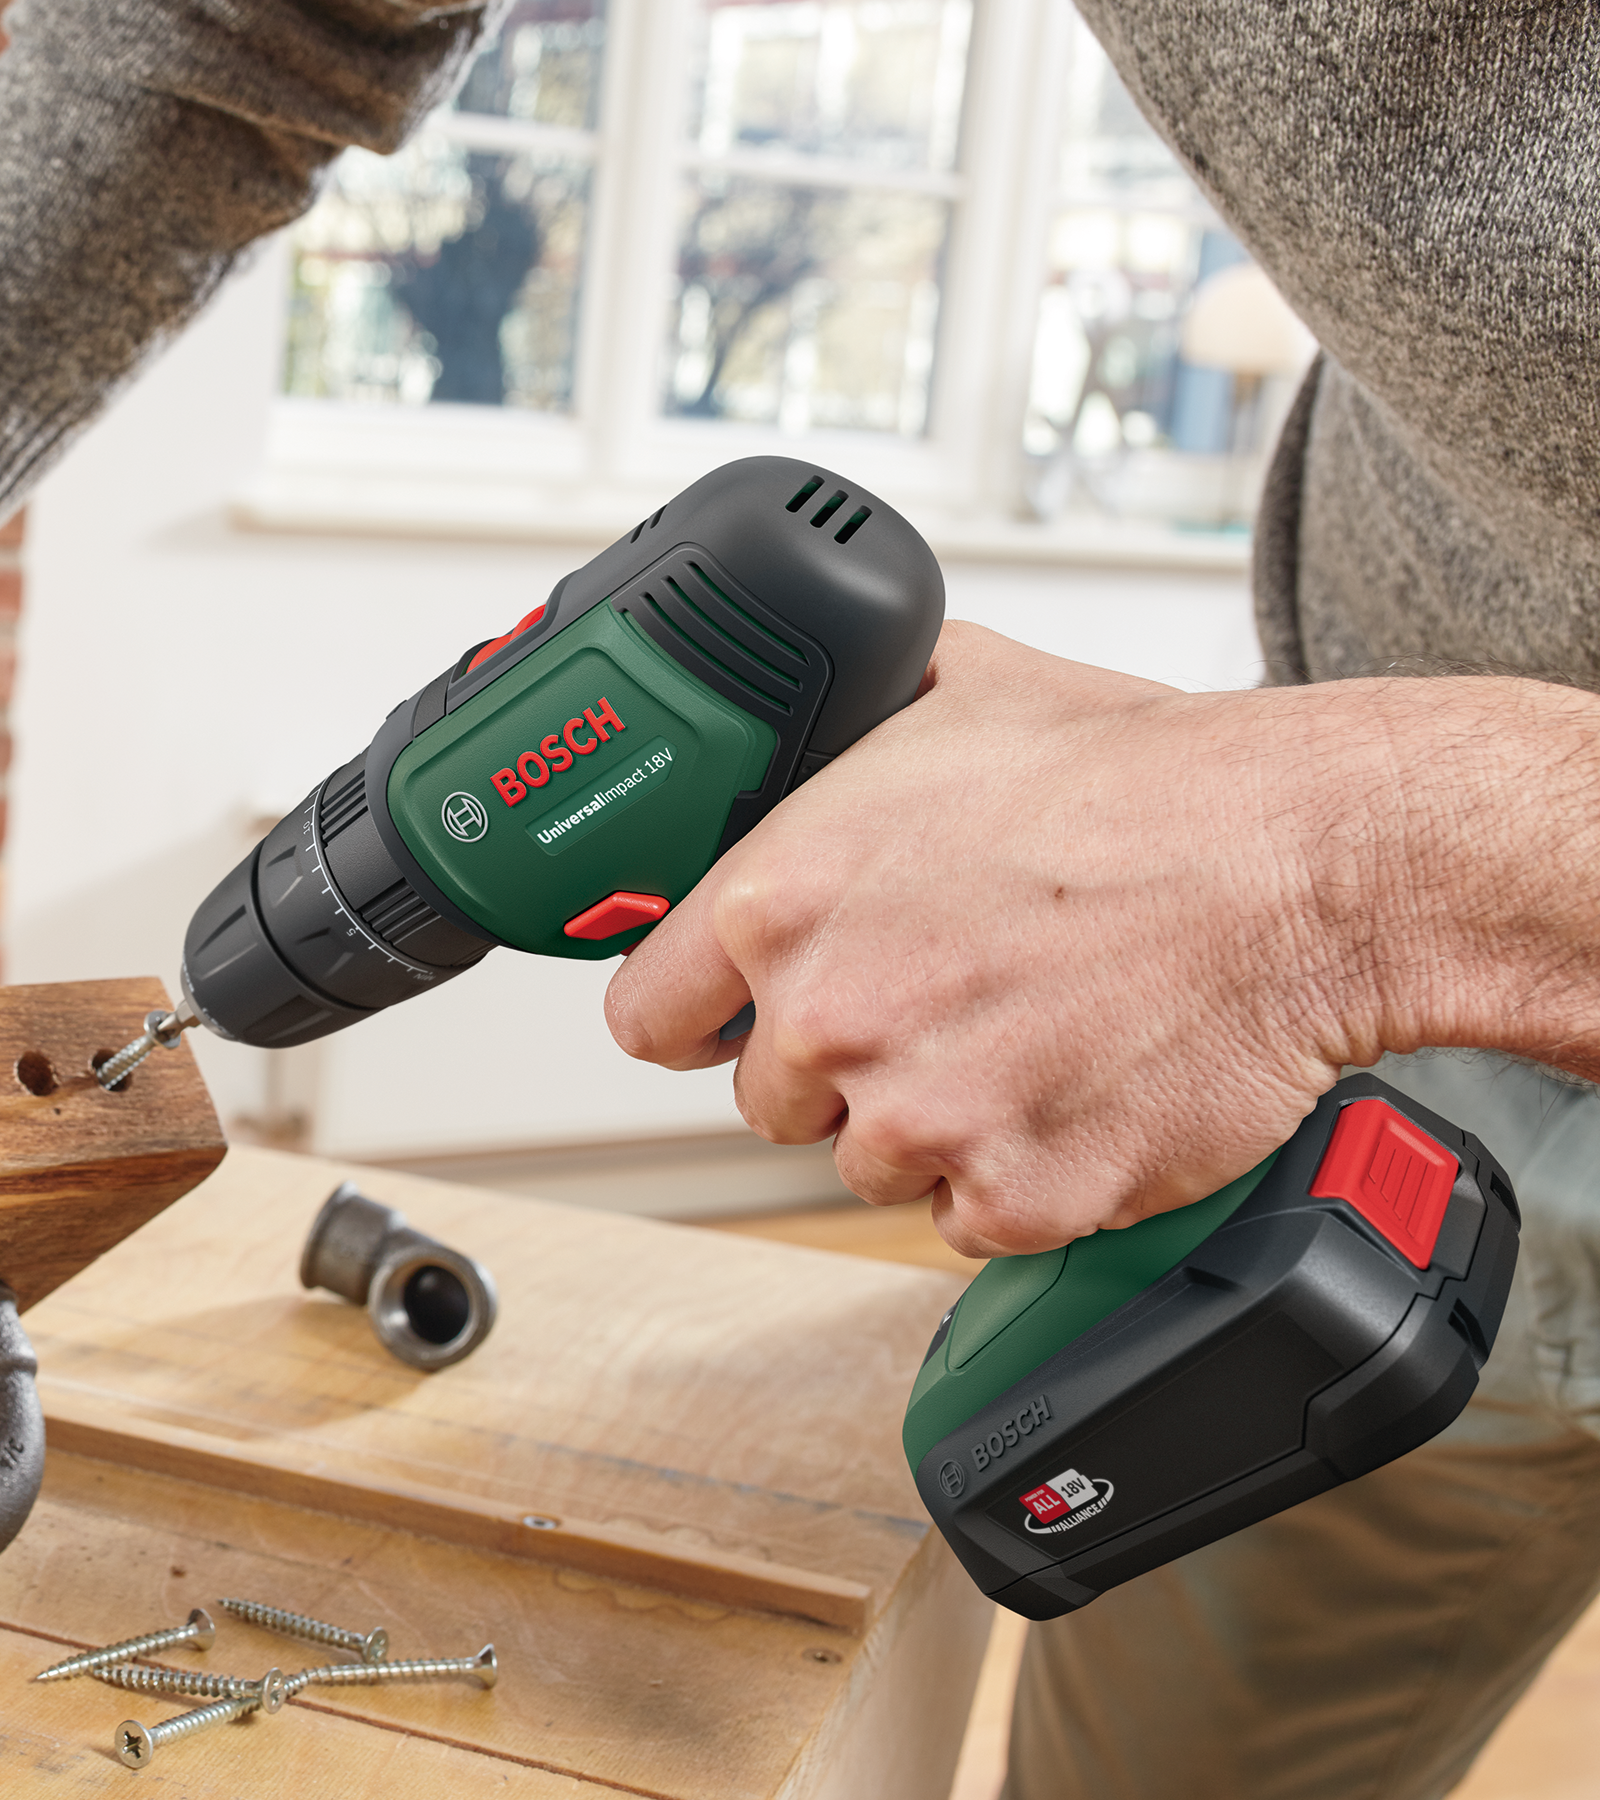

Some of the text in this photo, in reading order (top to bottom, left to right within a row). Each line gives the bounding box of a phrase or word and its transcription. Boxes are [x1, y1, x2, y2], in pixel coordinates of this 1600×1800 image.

[489, 696, 627, 808] BOSCH
[536, 747, 673, 844] UniversalImpact 18V
[302, 820, 311, 835] 10
[346, 927, 356, 937] 5
[413, 972, 436, 981] MIN
[970, 1394, 1052, 1473] BOSCH
[1060, 1477, 1087, 1498] 18V
[1032, 1494, 1061, 1515] ALL
[1059, 1503, 1102, 1532] ALLIANCE
